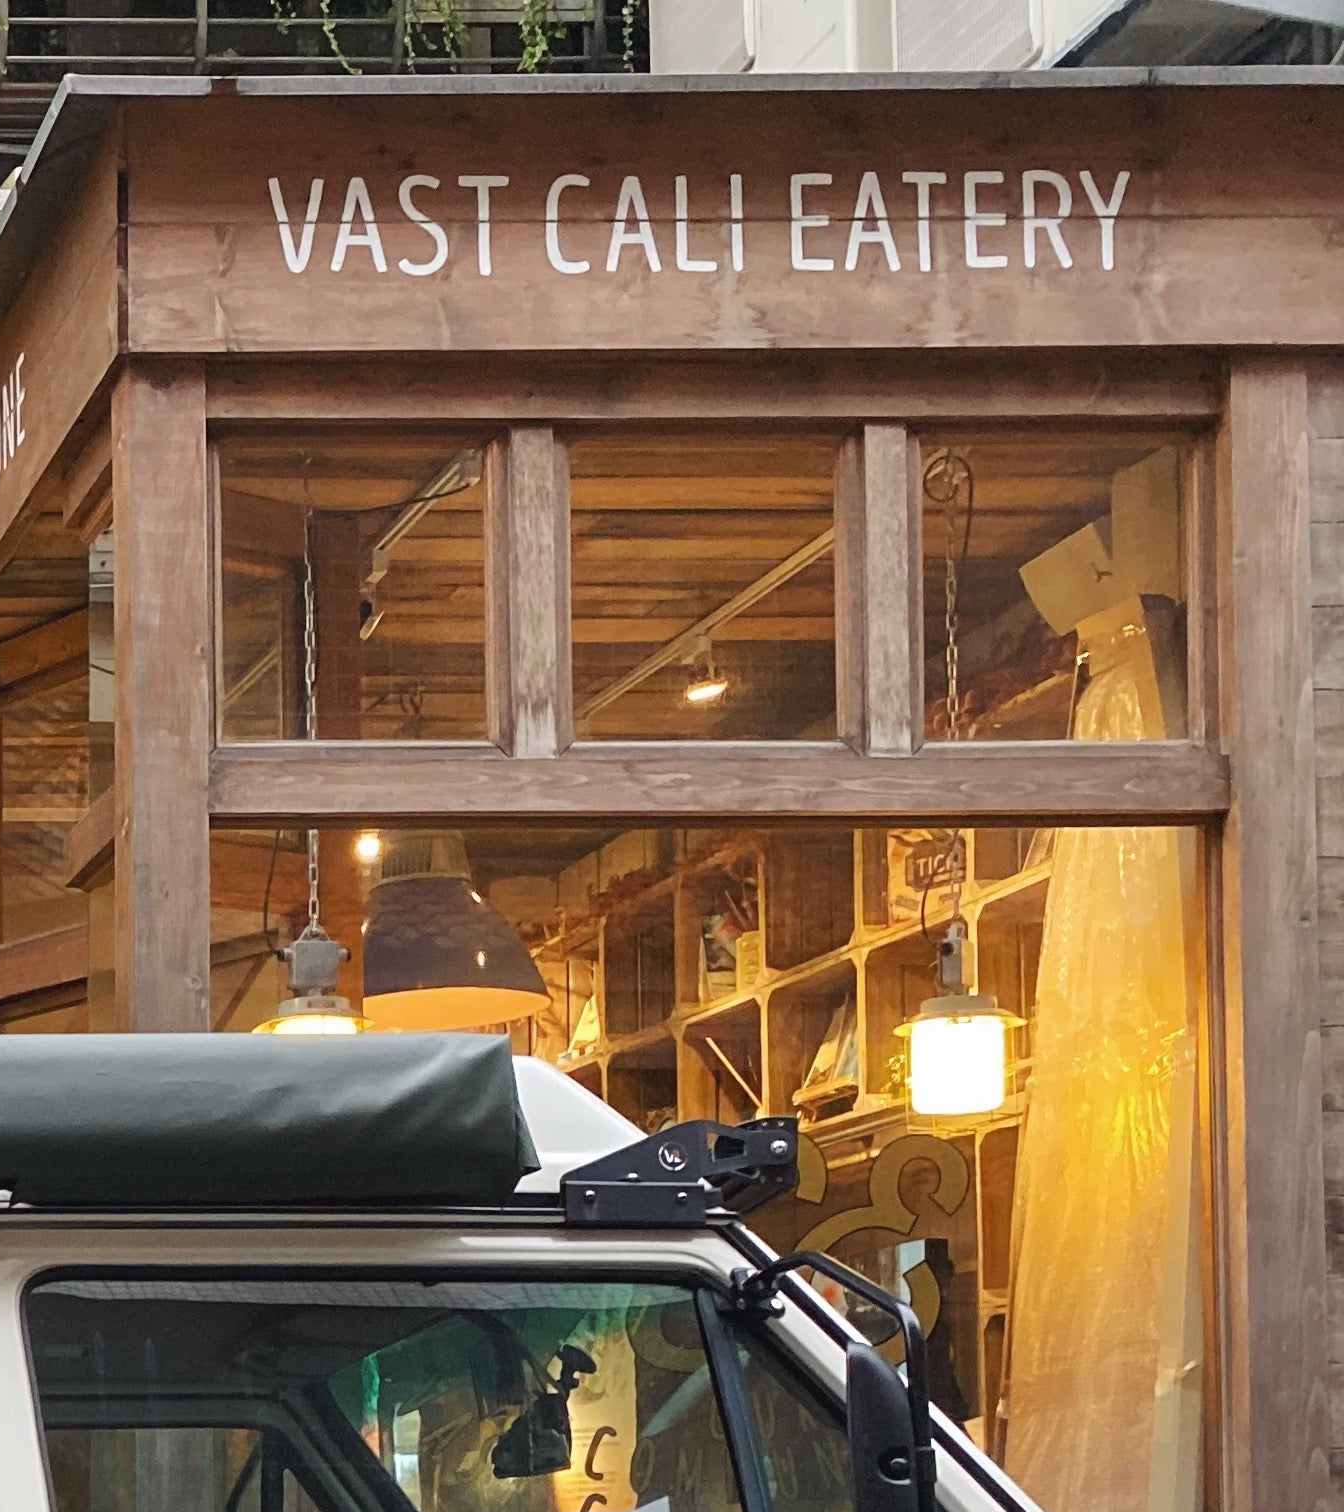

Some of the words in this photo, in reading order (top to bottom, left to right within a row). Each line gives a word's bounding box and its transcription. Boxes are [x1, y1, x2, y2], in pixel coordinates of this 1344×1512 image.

[268, 173, 509, 276] VAST
[545, 173, 744, 275] CALI
[789, 170, 1131, 272] EATERY
